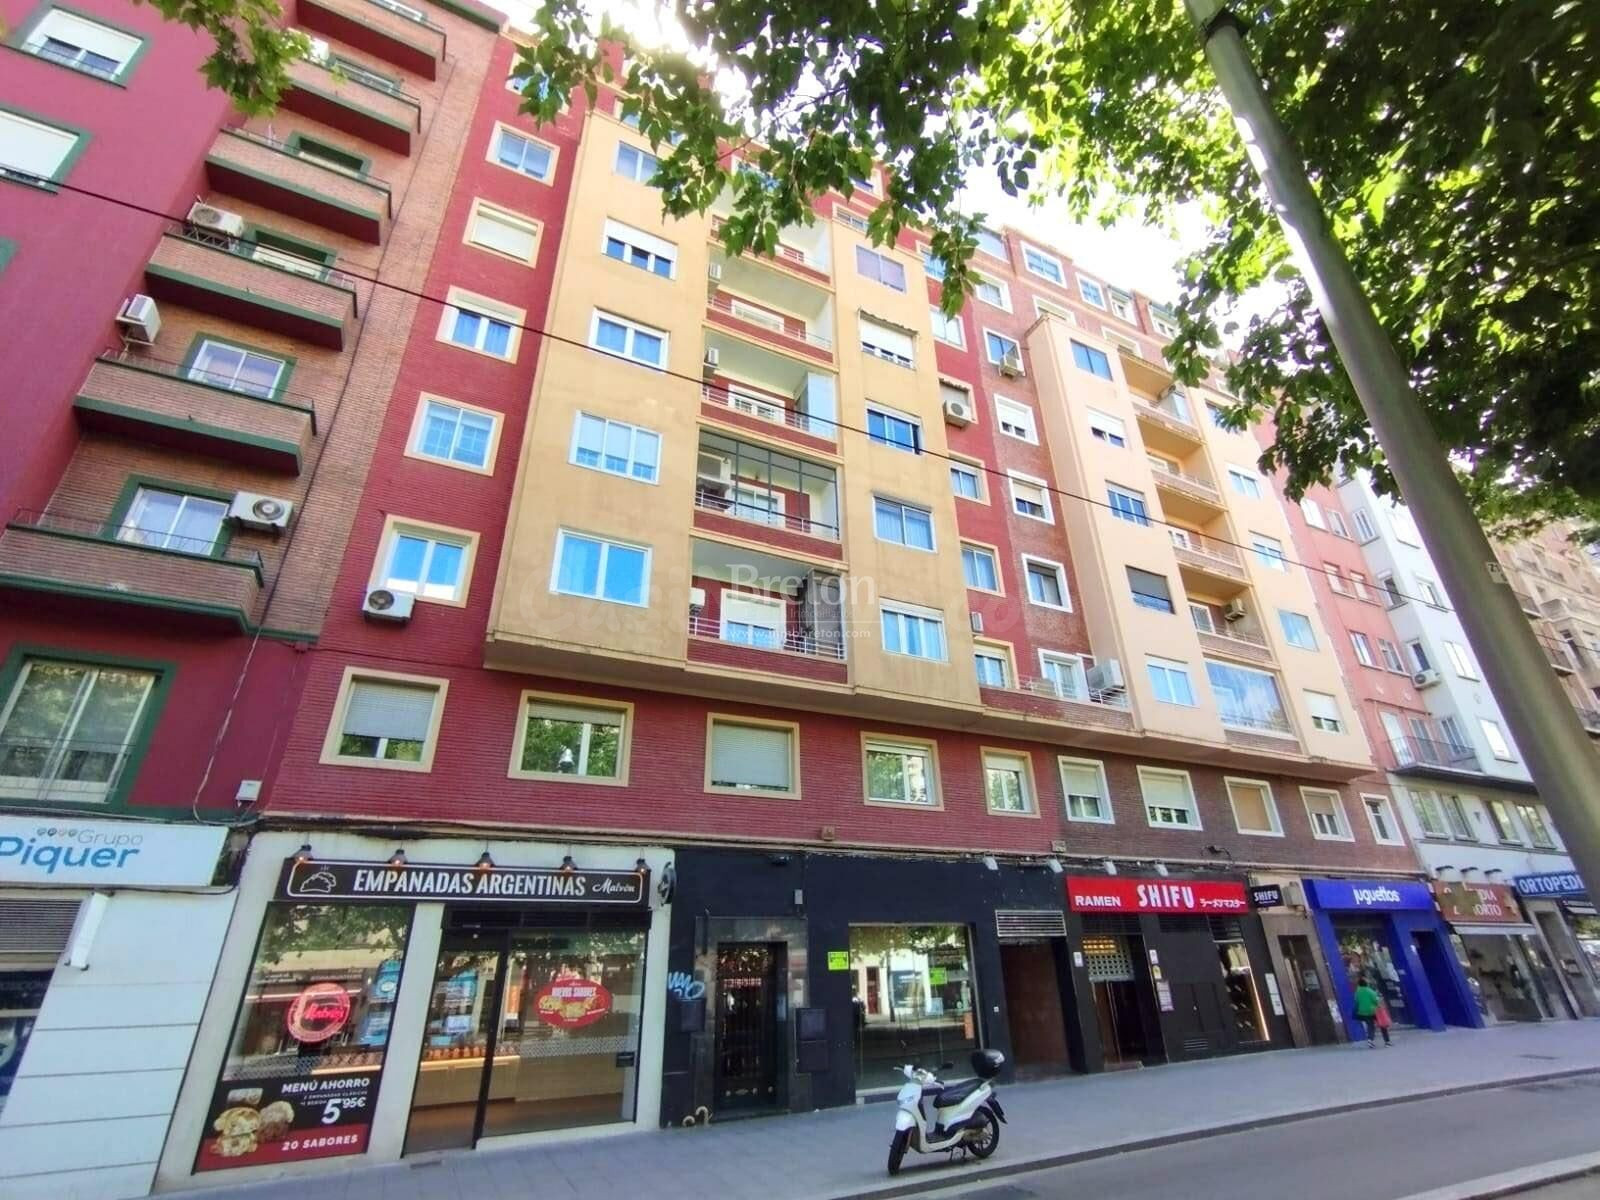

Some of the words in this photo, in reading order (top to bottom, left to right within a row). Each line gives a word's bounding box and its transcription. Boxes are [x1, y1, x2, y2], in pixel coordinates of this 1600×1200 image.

[77, 829, 143, 847] Grupo
[0, 835, 140, 874] Piquer
[353, 869, 474, 894] EMPANADAS
[475, 872, 587, 897] ARGENTINAS
[1075, 895, 1122, 906] RAMEN
[1137, 884, 1195, 909] SHIFU
[1253, 890, 1279, 902] SHIFU
[281, 1079, 319, 1094] MENÚ
[319, 1078, 371, 1091] AHORRO
[281, 1142, 300, 1151] 20
[302, 1134, 359, 1150] SABORES
